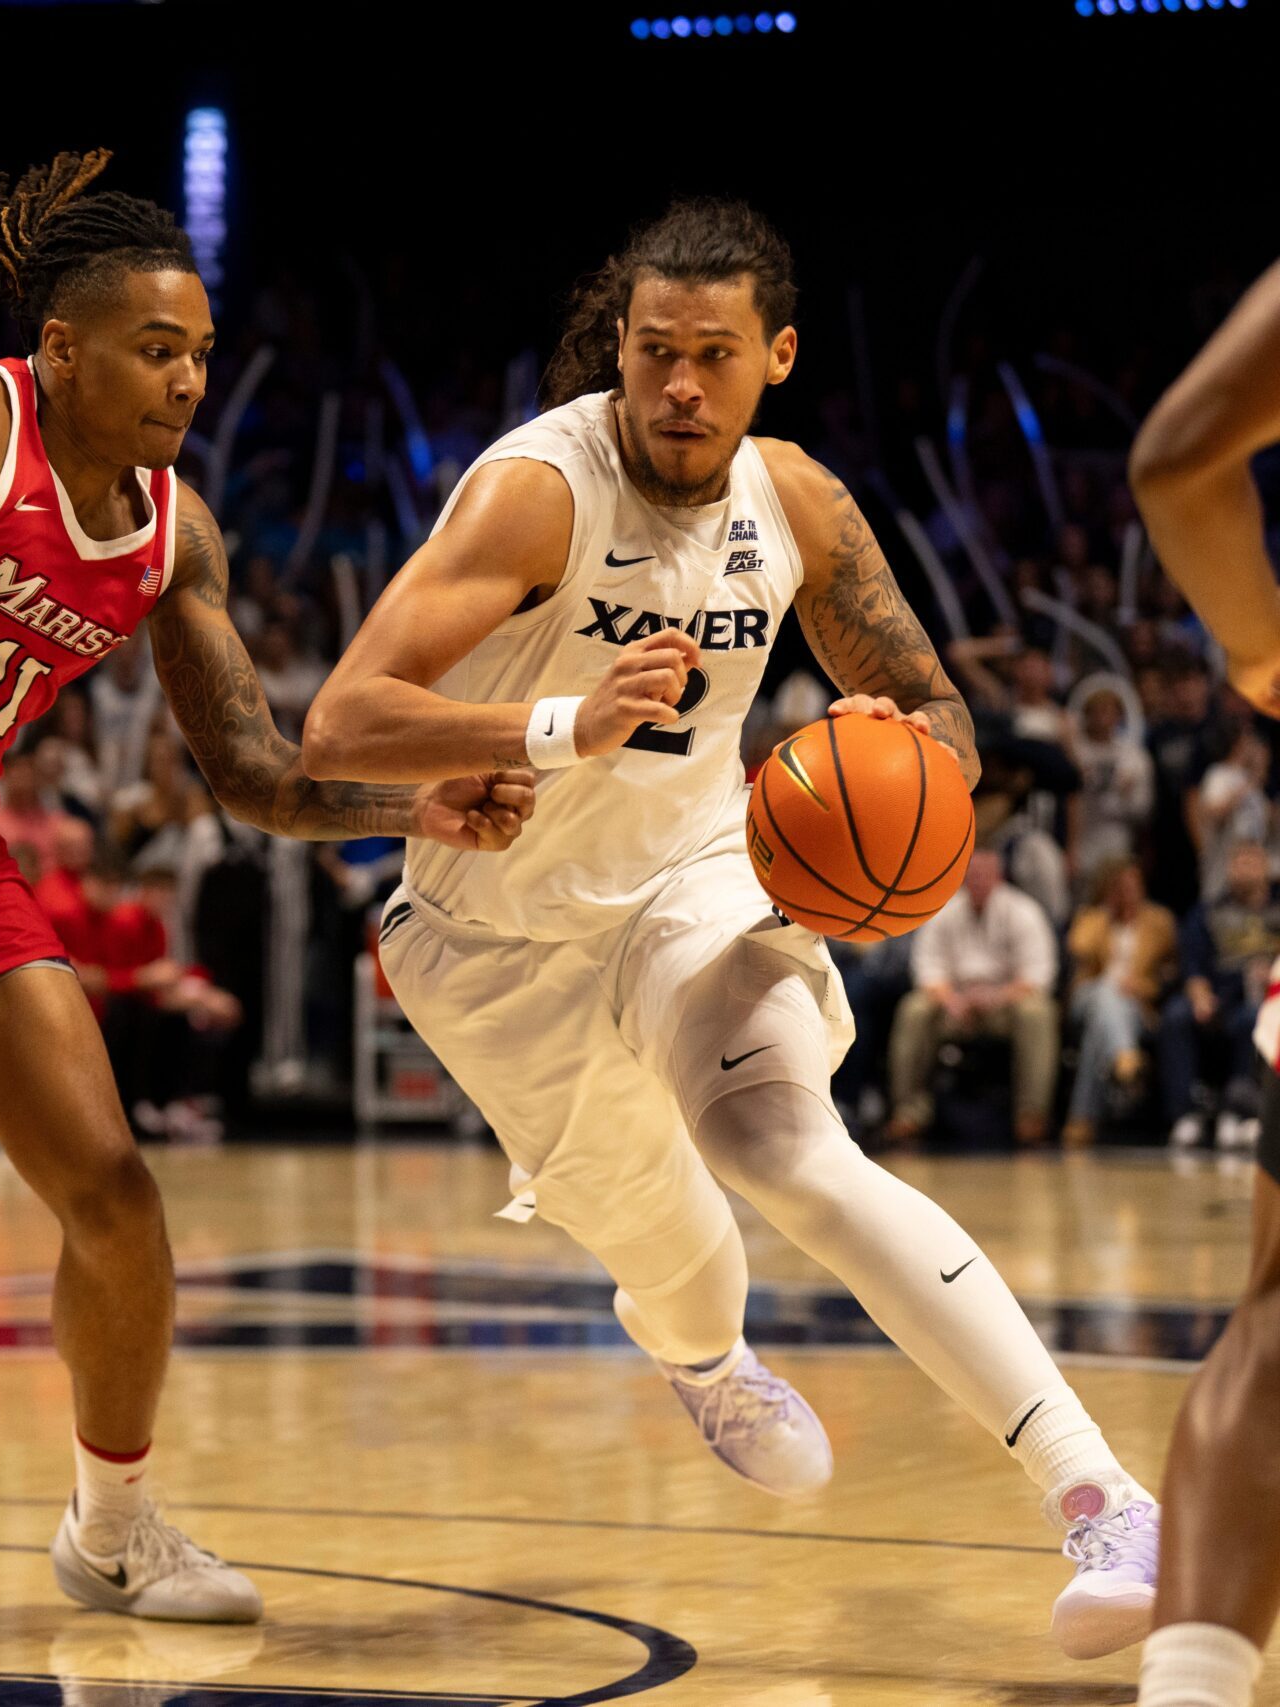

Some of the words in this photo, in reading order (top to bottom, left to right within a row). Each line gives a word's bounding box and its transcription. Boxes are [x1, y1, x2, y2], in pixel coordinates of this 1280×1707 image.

[731, 520, 745, 531] BE
[747, 519, 757, 530] TH
[728, 530, 759, 542] CHANG
[728, 549, 758, 561] BIG
[725, 559, 765, 571] EAST
[622, 666, 711, 757] 2
